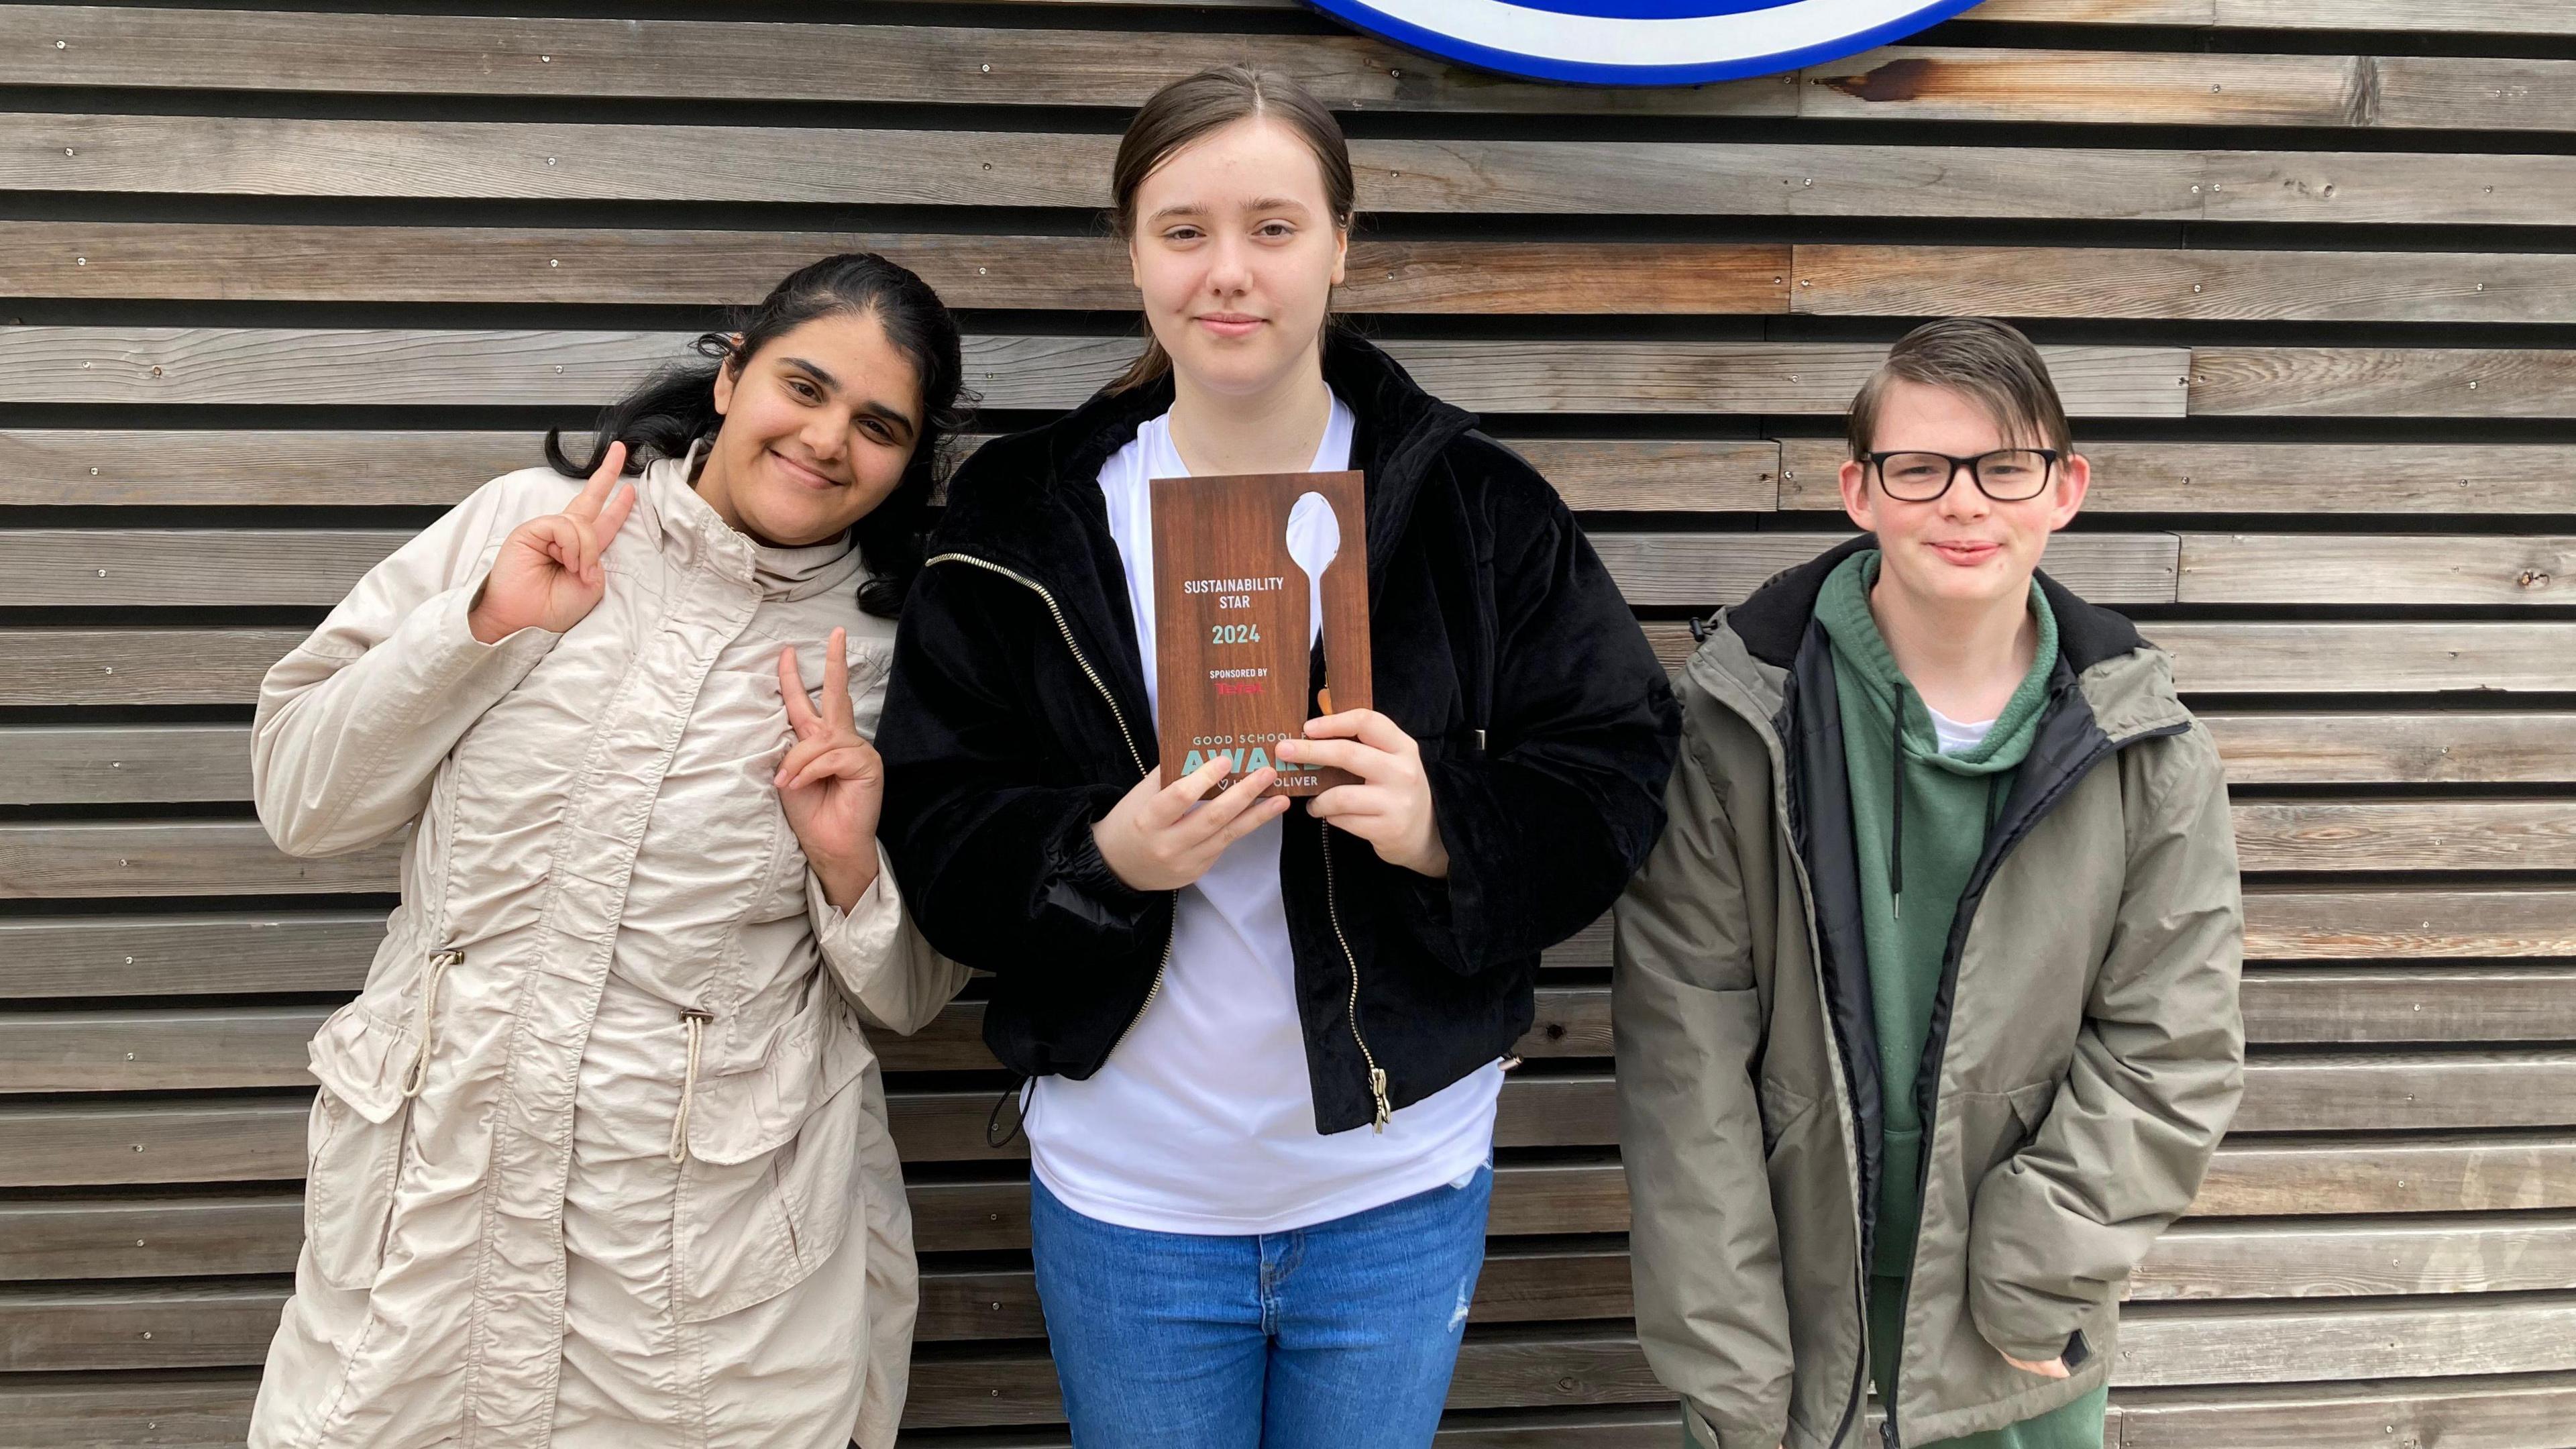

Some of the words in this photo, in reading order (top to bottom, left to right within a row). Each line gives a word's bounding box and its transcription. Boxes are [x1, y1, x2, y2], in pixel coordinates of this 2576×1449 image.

[1184, 577, 1284, 594] SUSTAINABILITY
[1220, 595, 1250, 609] STAR
[1212, 624, 1260, 644] 2024
[1210, 669, 1256, 679] SPONSORED
[1258, 668, 1268, 677] BY
[1193, 735, 1233, 745] GOOD
[1273, 776, 1318, 787] OLIVER
